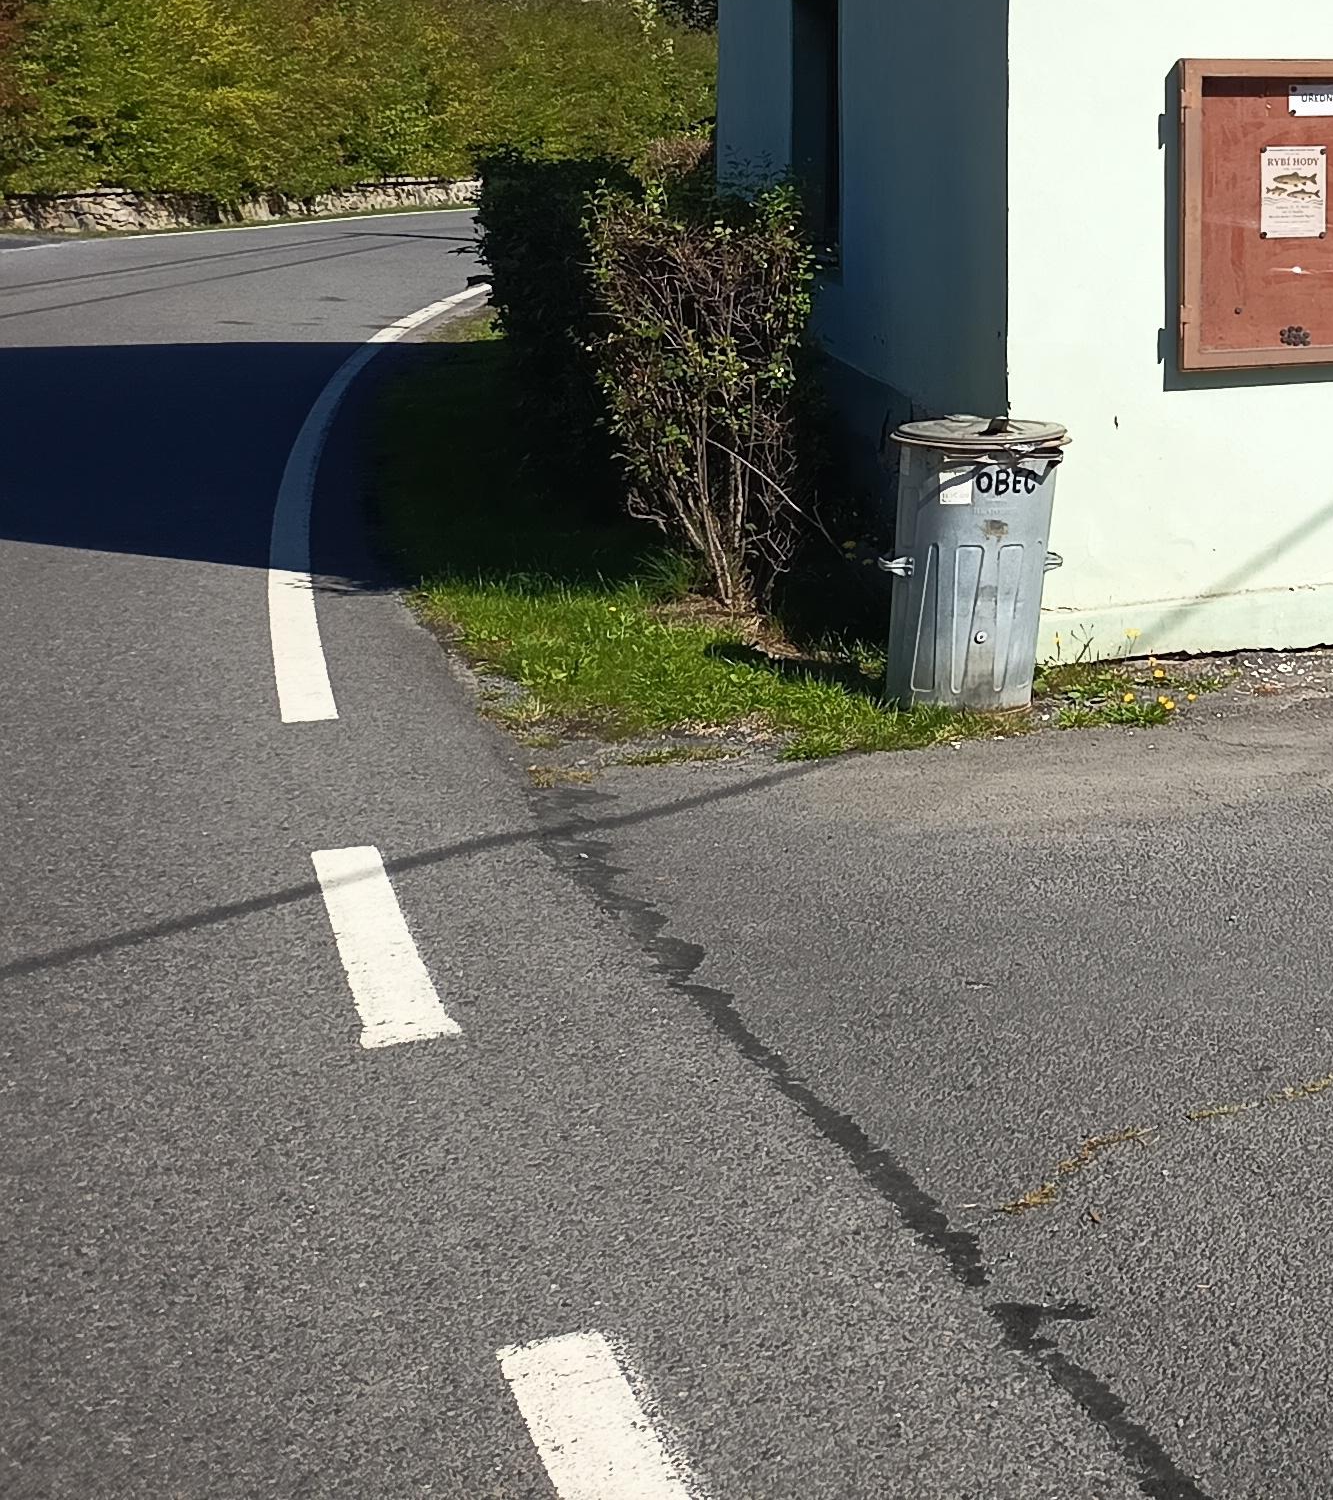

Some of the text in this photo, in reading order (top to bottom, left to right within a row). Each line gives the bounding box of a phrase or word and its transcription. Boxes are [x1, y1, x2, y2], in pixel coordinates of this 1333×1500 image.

[1267, 156, 1319, 166] RYBÍ HODY
[975, 469, 1036, 496] OBEC
